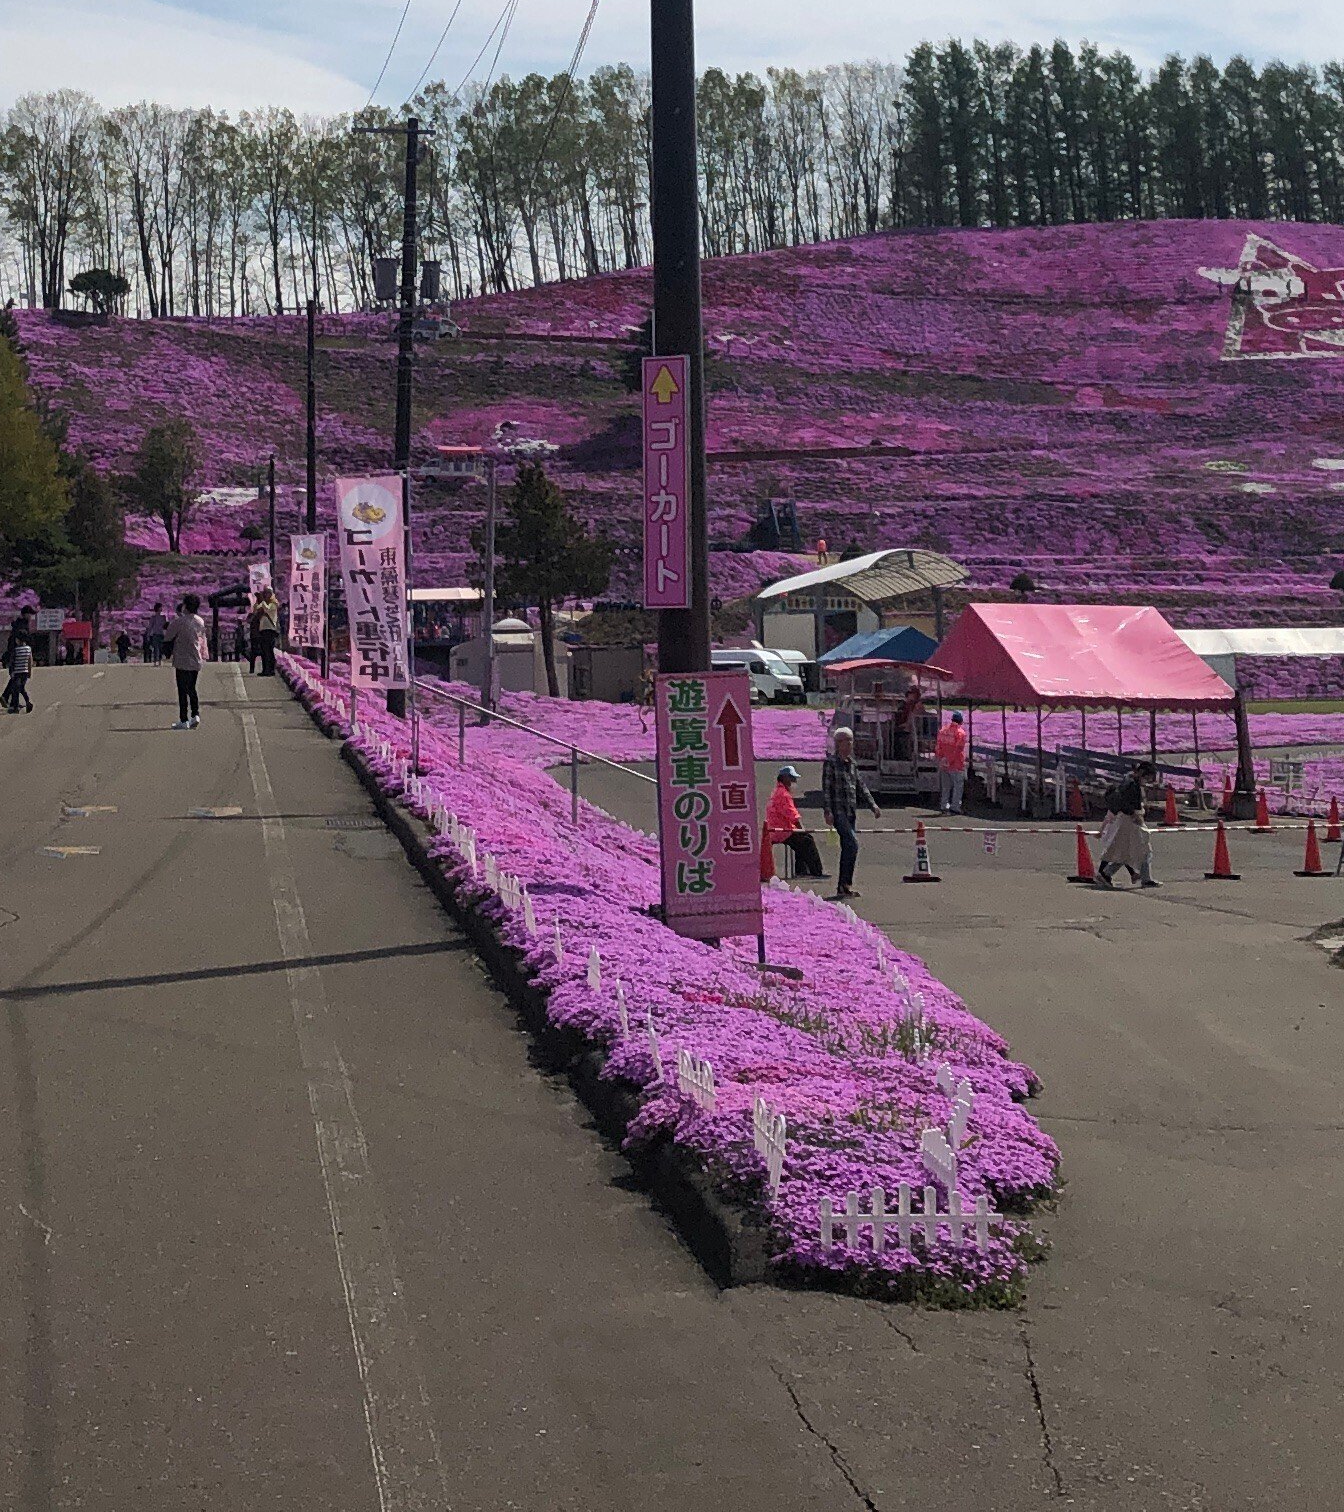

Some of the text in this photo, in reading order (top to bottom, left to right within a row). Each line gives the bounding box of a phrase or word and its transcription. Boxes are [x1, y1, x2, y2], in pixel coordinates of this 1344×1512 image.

[650, 417, 680, 594] ゴーカート
[667, 679, 716, 894] 遊覧車のりば
[718, 781, 752, 854] 直進
[914, 846, 929, 871] 出口
